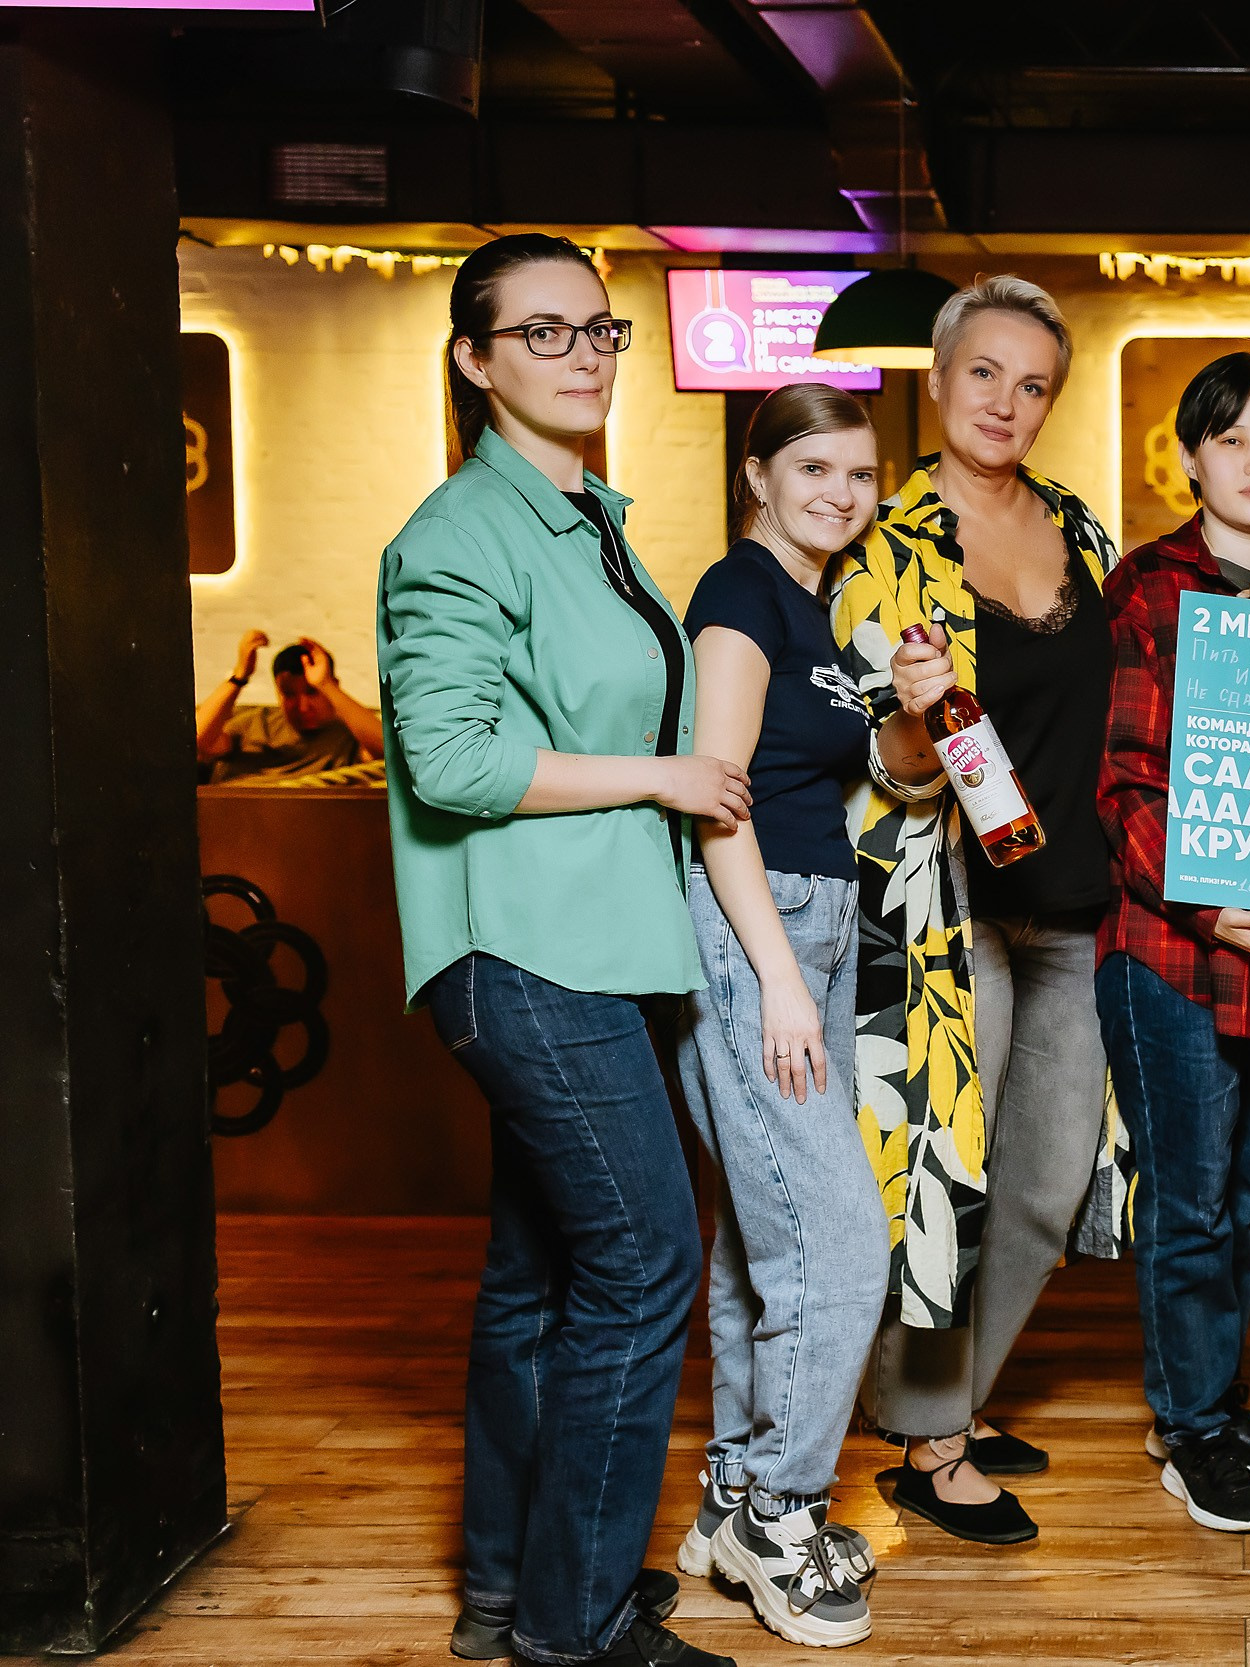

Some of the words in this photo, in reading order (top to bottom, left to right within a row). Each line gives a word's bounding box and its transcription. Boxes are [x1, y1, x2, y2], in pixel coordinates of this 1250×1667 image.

[752, 309, 765, 326] 2
[765, 308, 824, 327] МЕСТО
[703, 321, 736, 361] 2
[1193, 607, 1211, 634] 2
